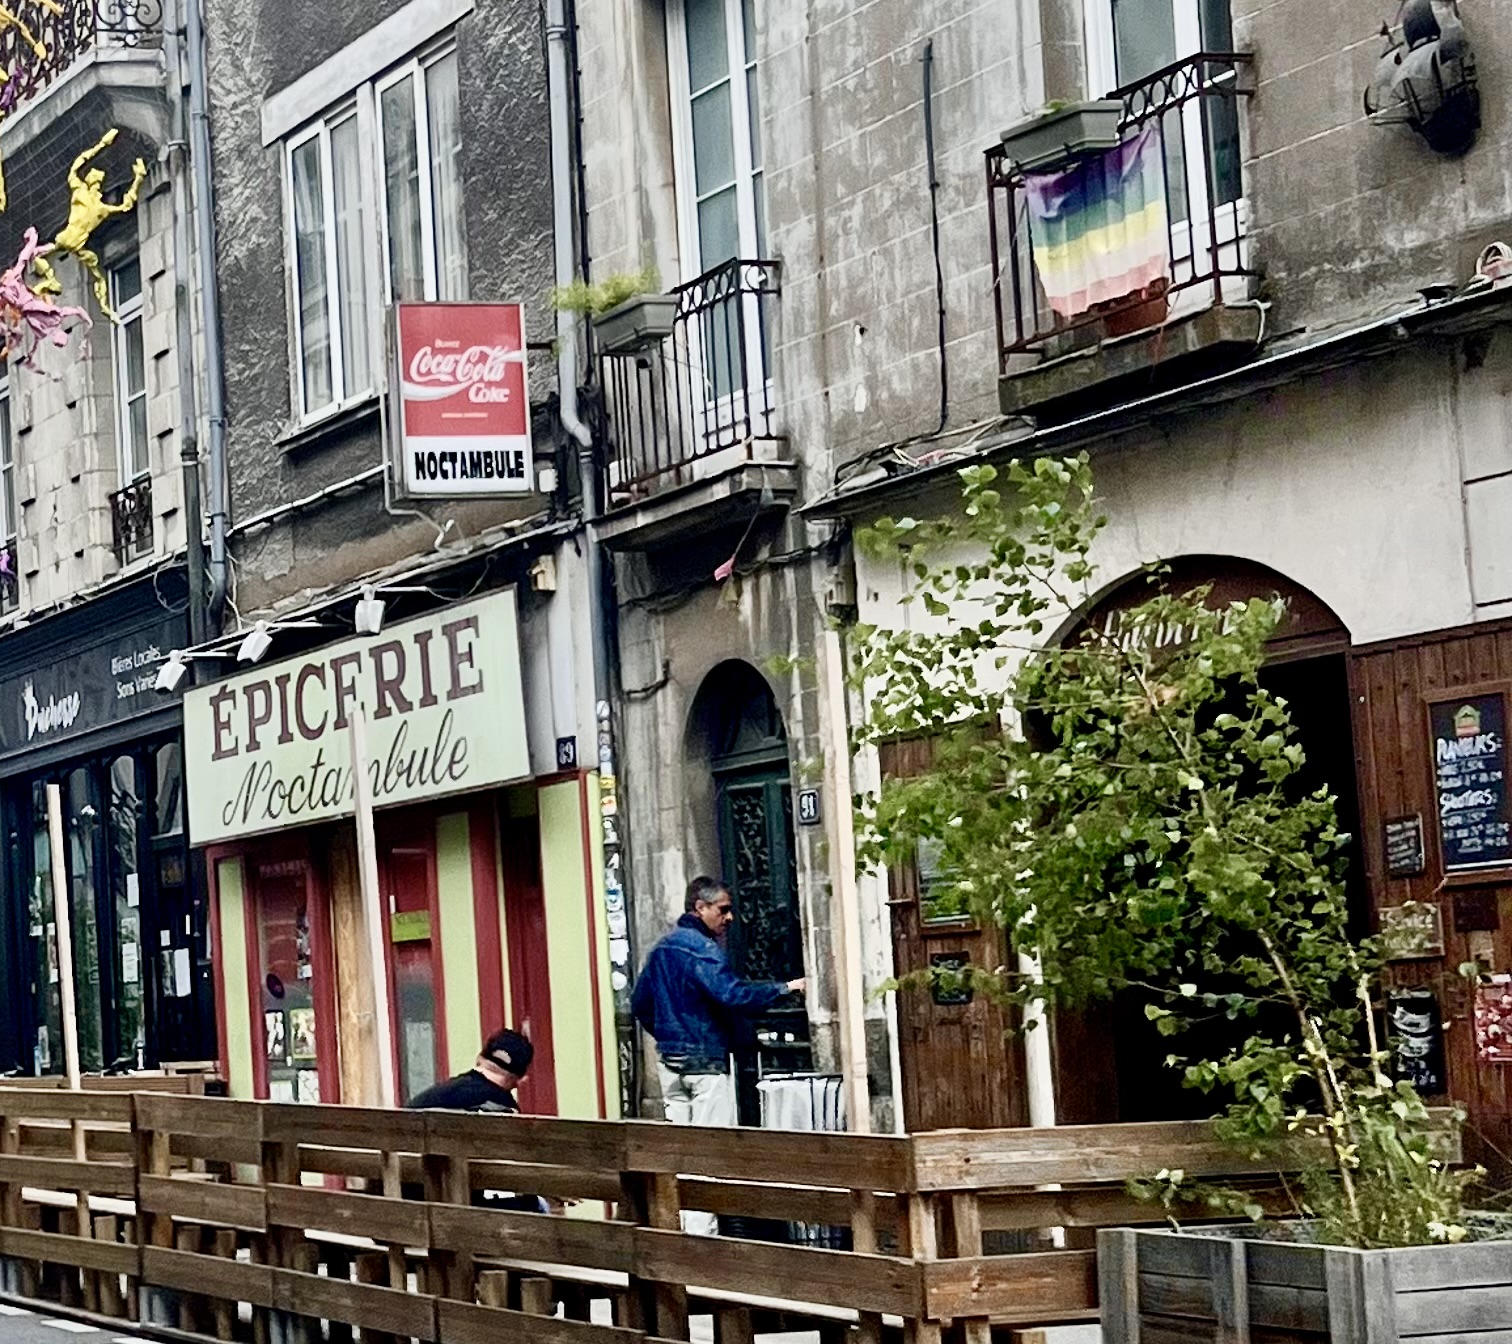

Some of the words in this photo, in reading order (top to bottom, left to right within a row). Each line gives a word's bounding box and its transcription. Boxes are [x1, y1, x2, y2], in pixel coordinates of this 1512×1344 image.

[410, 346, 509, 383] Coca-Cola
[468, 383, 510, 403] Coke
[414, 450, 525, 480] NOCTAMBULE
[209, 615, 484, 762] ÉPICERIE
[801, 794, 815, 818] 91
